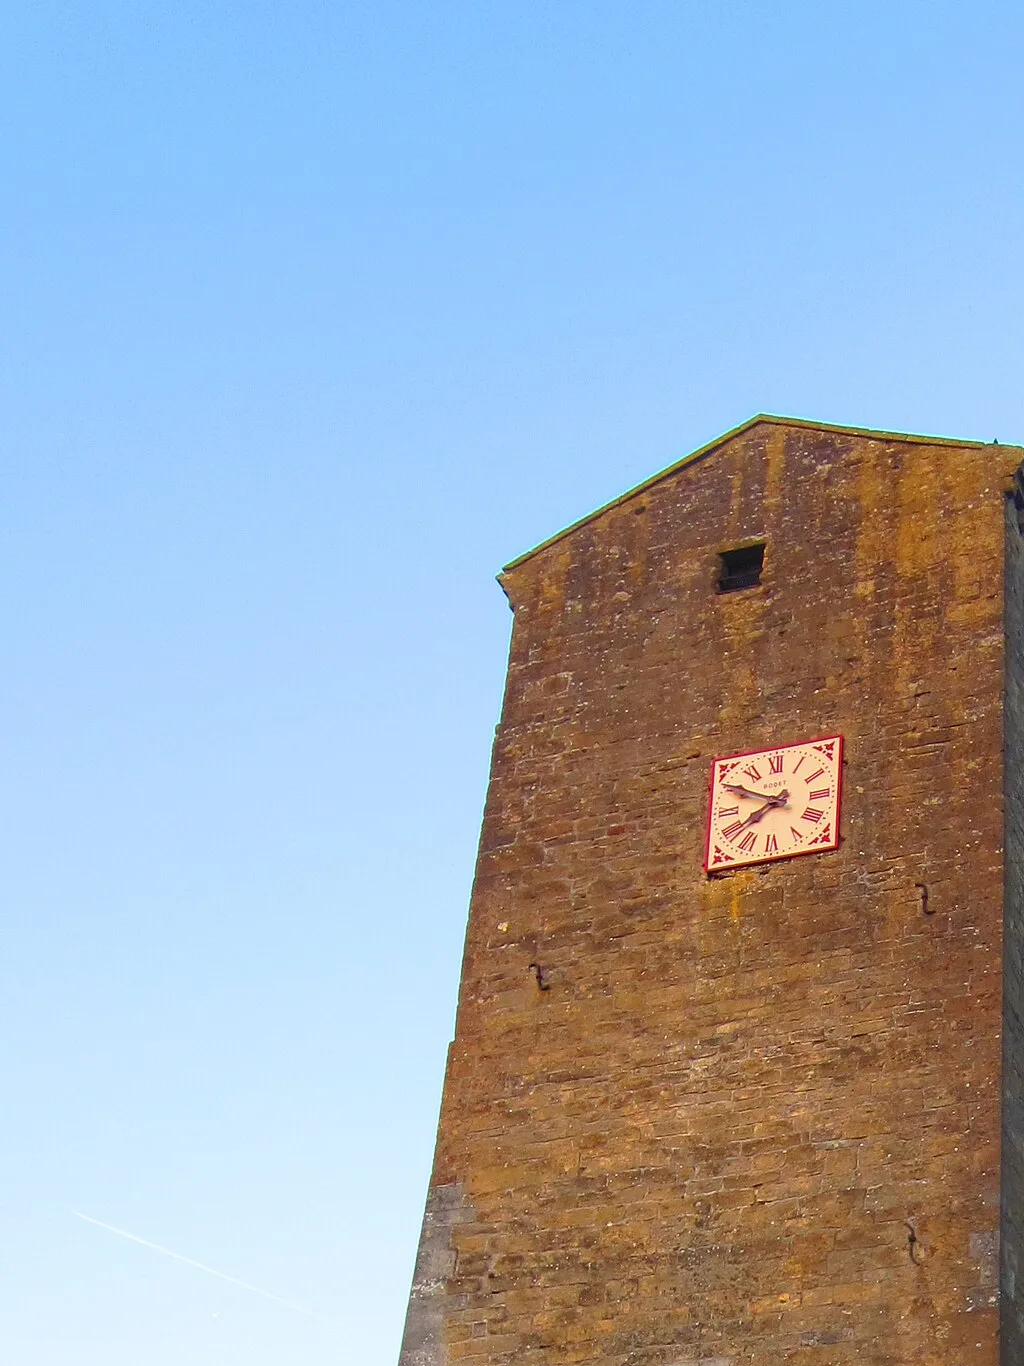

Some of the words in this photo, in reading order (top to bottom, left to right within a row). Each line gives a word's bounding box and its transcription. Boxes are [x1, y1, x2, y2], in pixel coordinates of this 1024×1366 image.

[768, 755, 783, 775] XII
[810, 788, 830, 800] III
[738, 832, 759, 852] VII
[765, 834, 778, 852] VI
